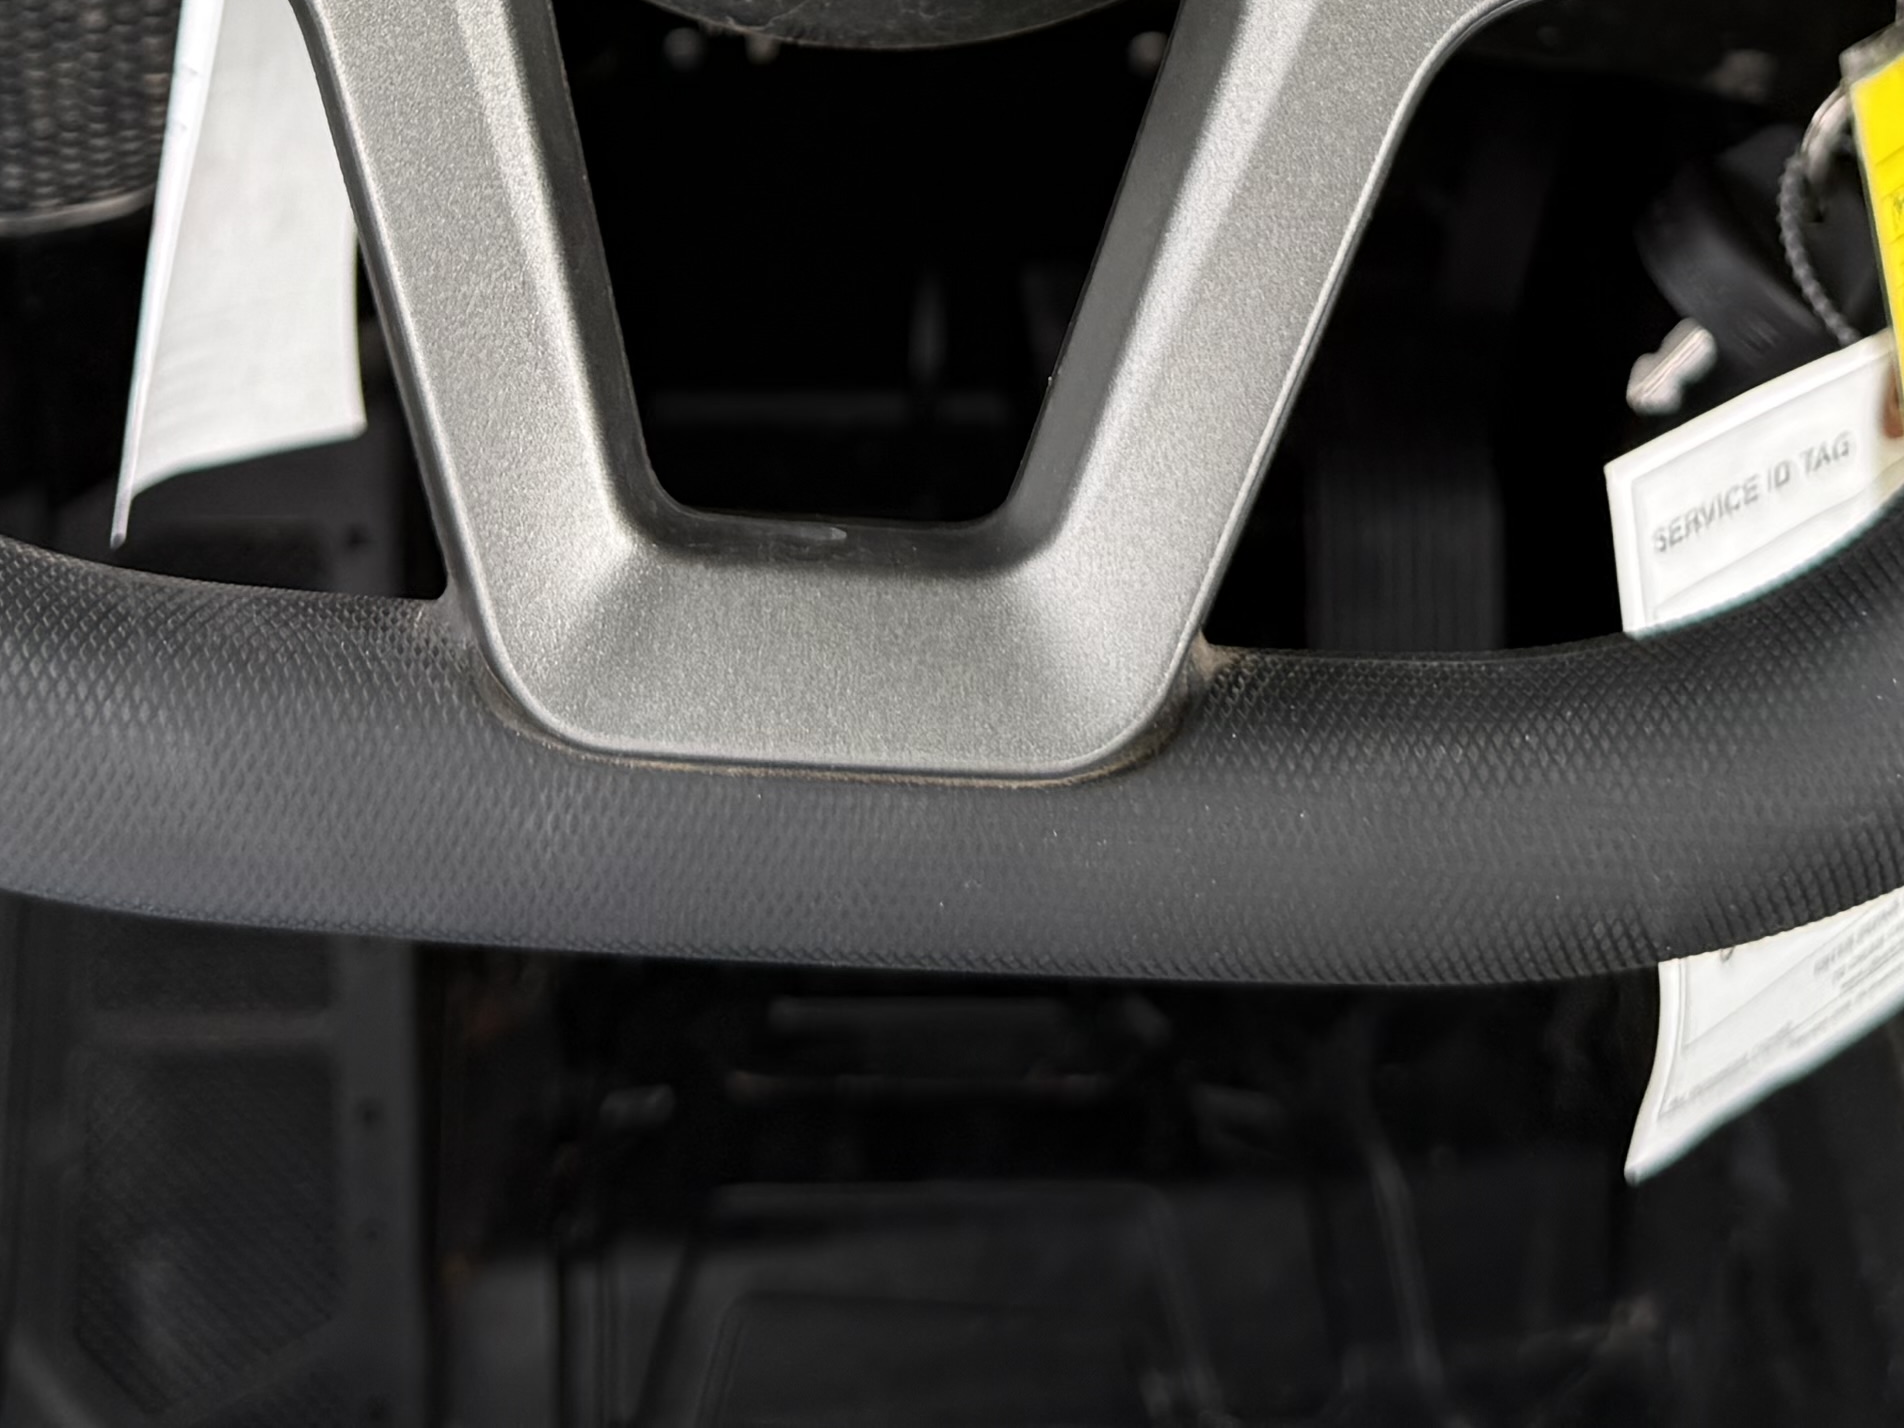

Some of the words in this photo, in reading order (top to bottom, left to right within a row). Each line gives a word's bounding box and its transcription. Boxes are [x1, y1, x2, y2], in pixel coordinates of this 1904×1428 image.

[1652, 480, 1763, 553] SERVICE
[1765, 458, 1793, 494] ID
[1802, 428, 1854, 479] TAG
